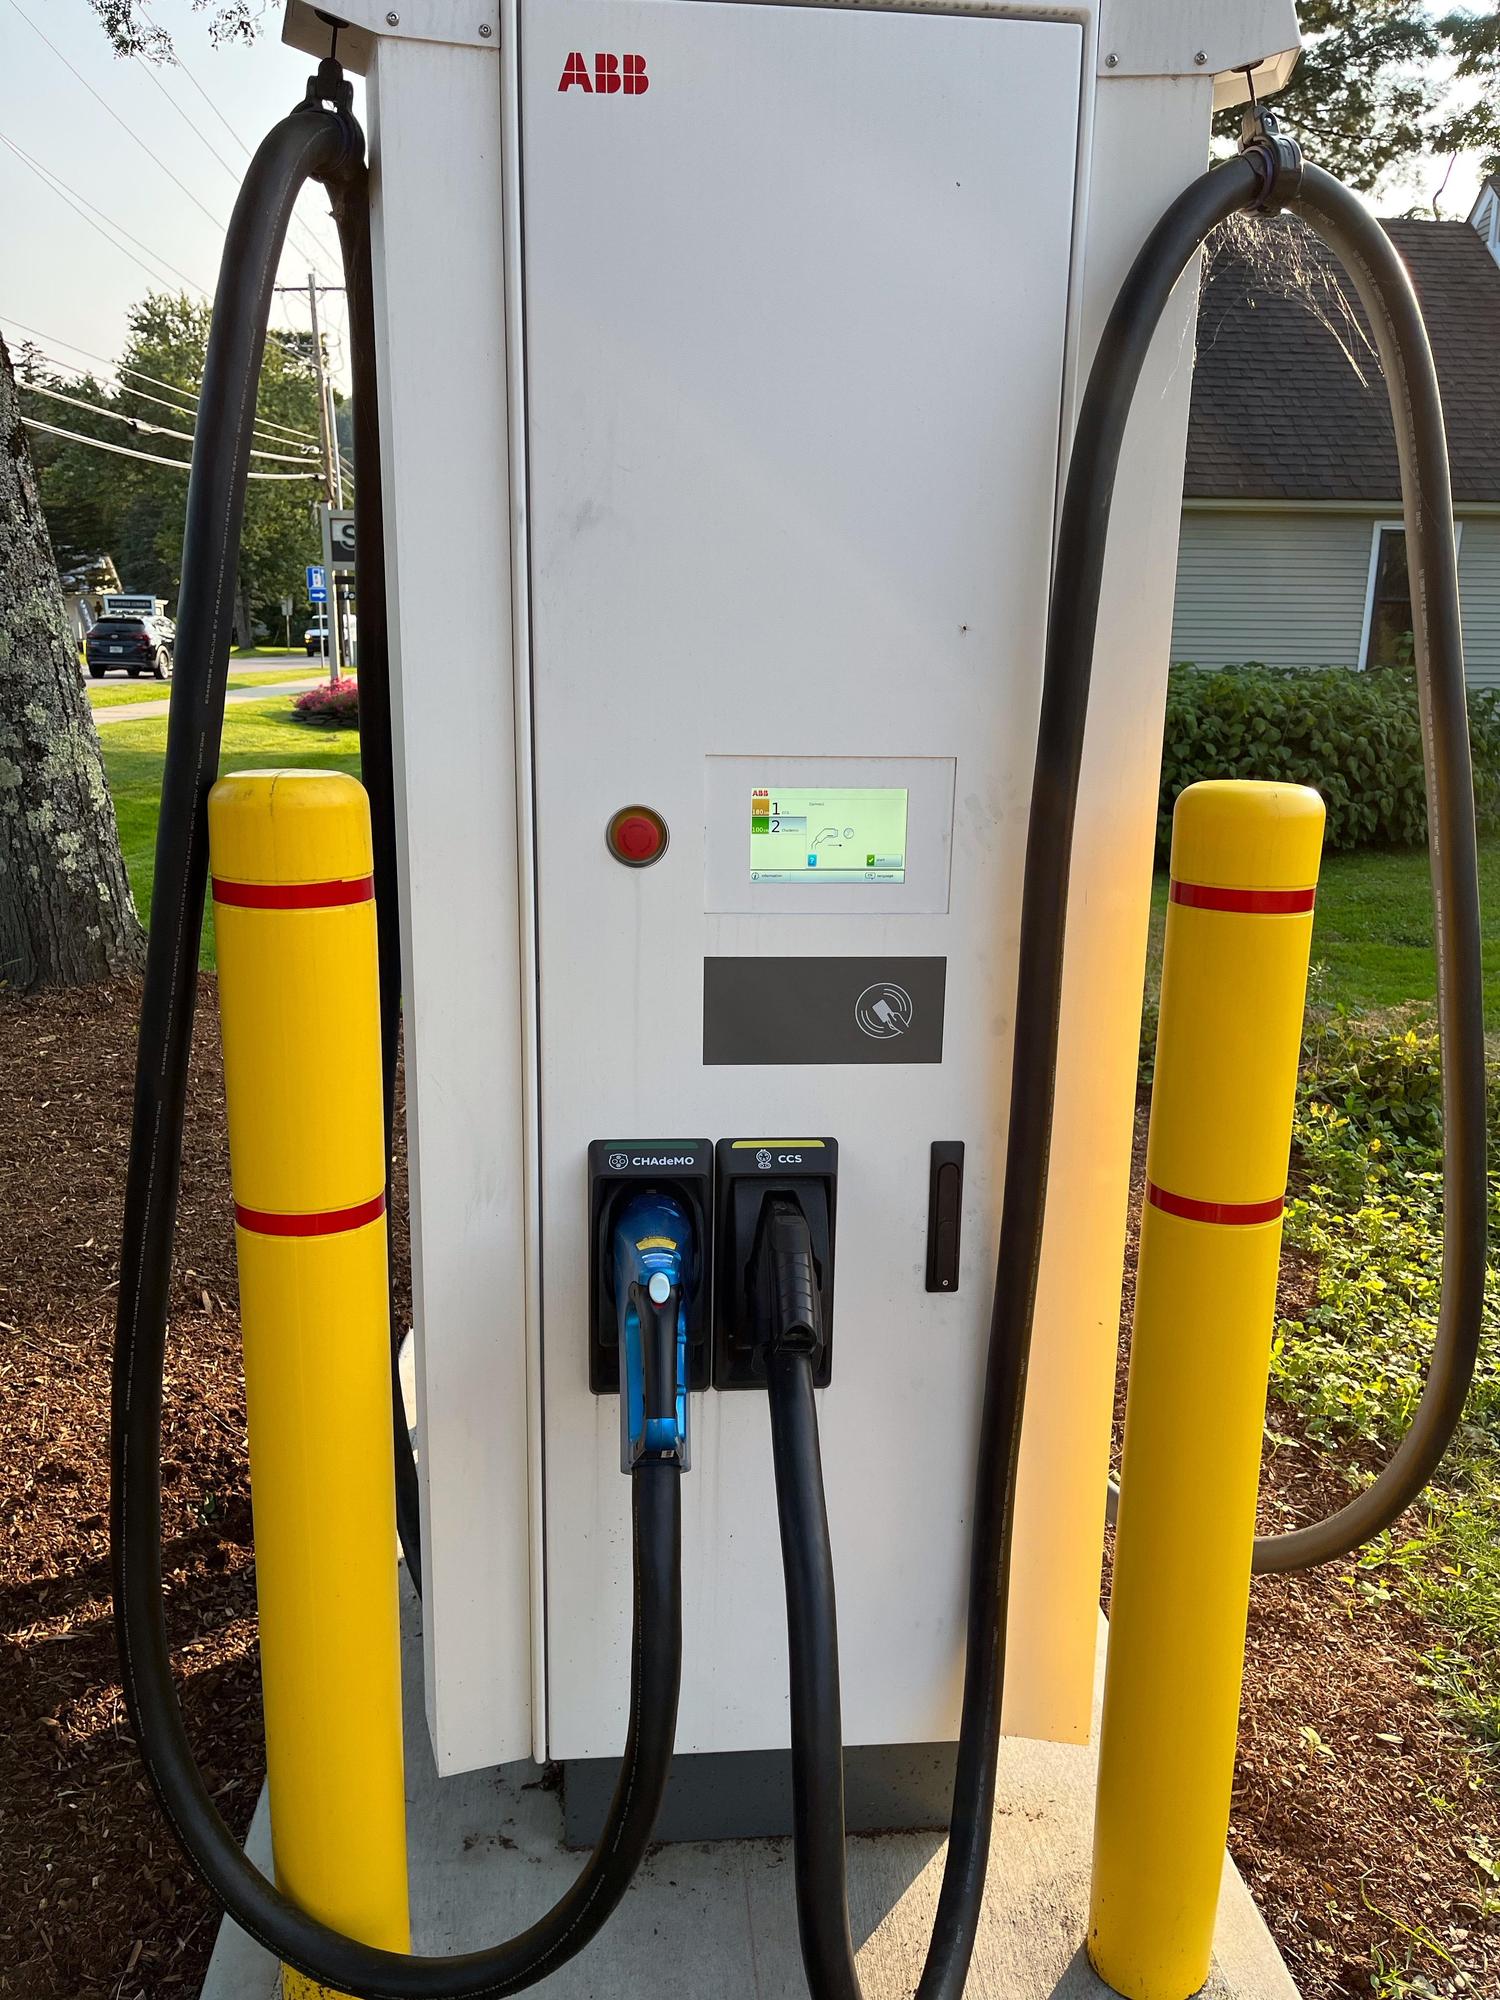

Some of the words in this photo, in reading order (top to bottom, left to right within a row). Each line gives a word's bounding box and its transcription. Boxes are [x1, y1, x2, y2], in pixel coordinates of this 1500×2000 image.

[557, 52, 650, 95] ABB
[772, 802, 781, 815] 1
[771, 819, 780, 833] 2
[632, 1156, 695, 1166] CHAdeMO
[777, 1154, 803, 1164] CCS
